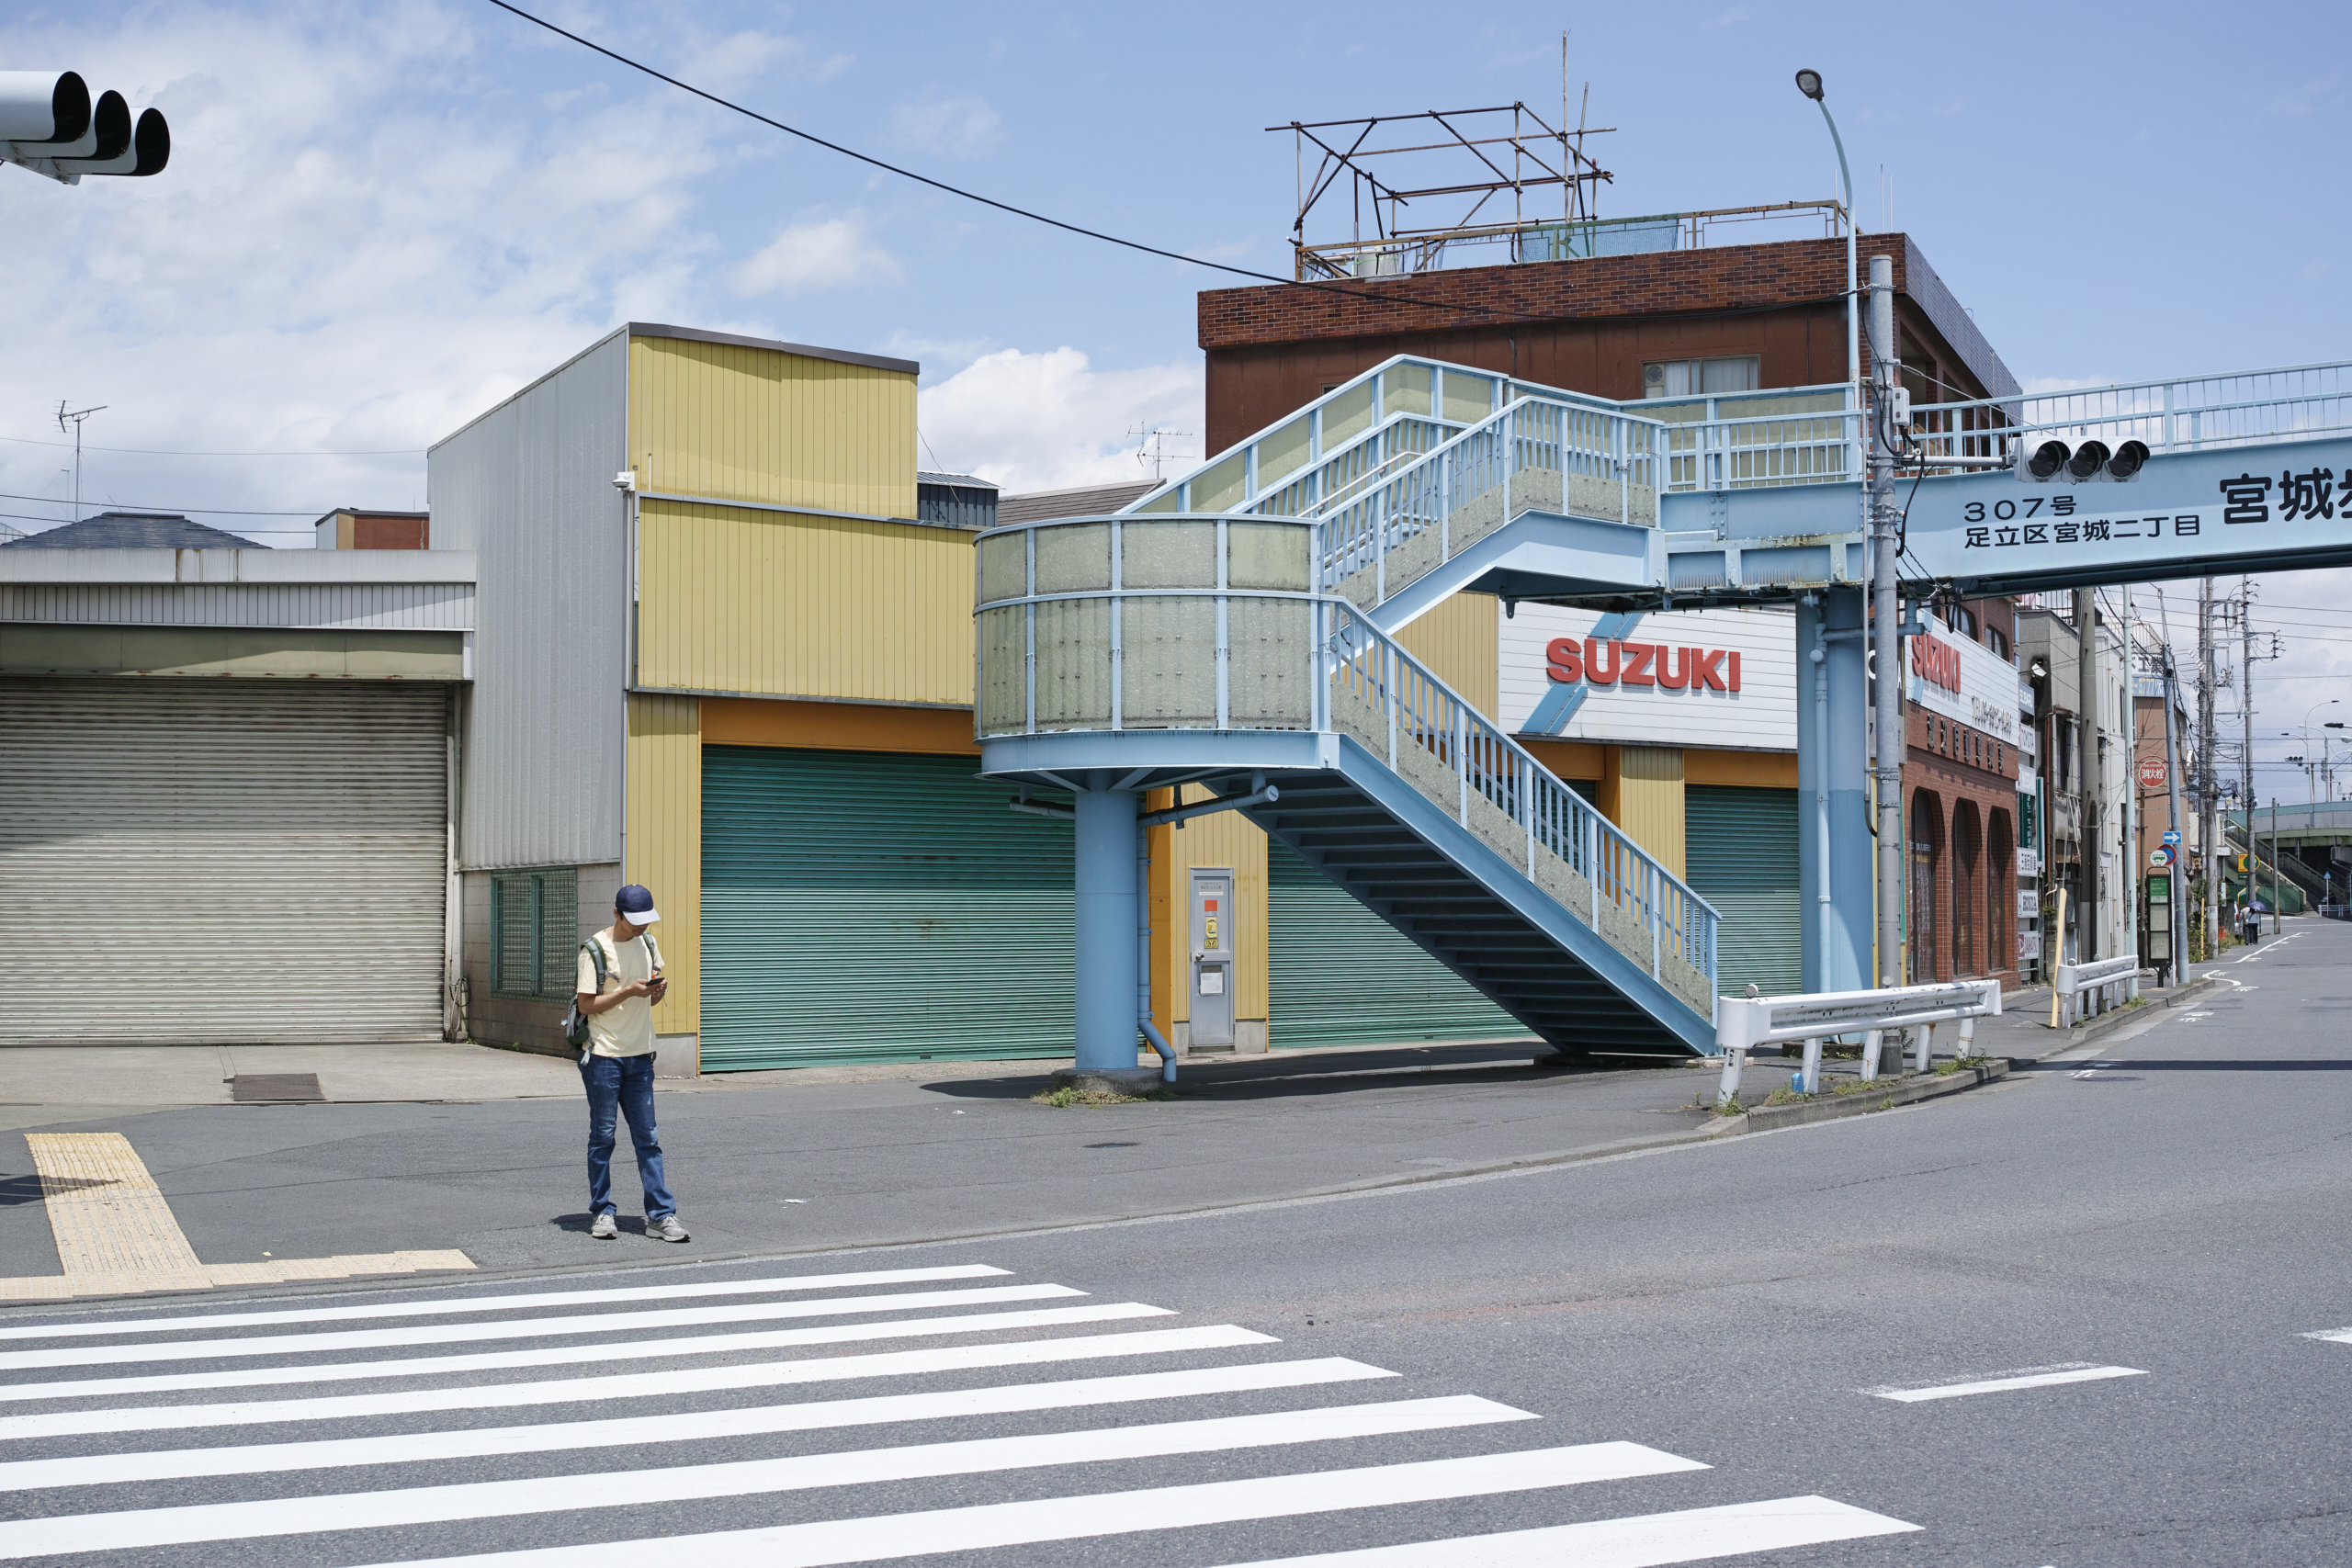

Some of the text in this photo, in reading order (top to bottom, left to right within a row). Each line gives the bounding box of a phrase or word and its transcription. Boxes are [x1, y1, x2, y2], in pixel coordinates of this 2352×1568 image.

[1964, 495, 2077, 523] 307号
[2220, 467, 2352, 525] 宮城
[1964, 515, 2199, 549] 足立区宮城二丁目
[1545, 637, 1741, 692] SUZUKI
[1911, 631, 1962, 694] SUZUKI
[2020, 728, 2035, 750] TOYOTA
[2142, 768, 2165, 780] 消火栓
[2022, 895, 2038, 912] HONDA
